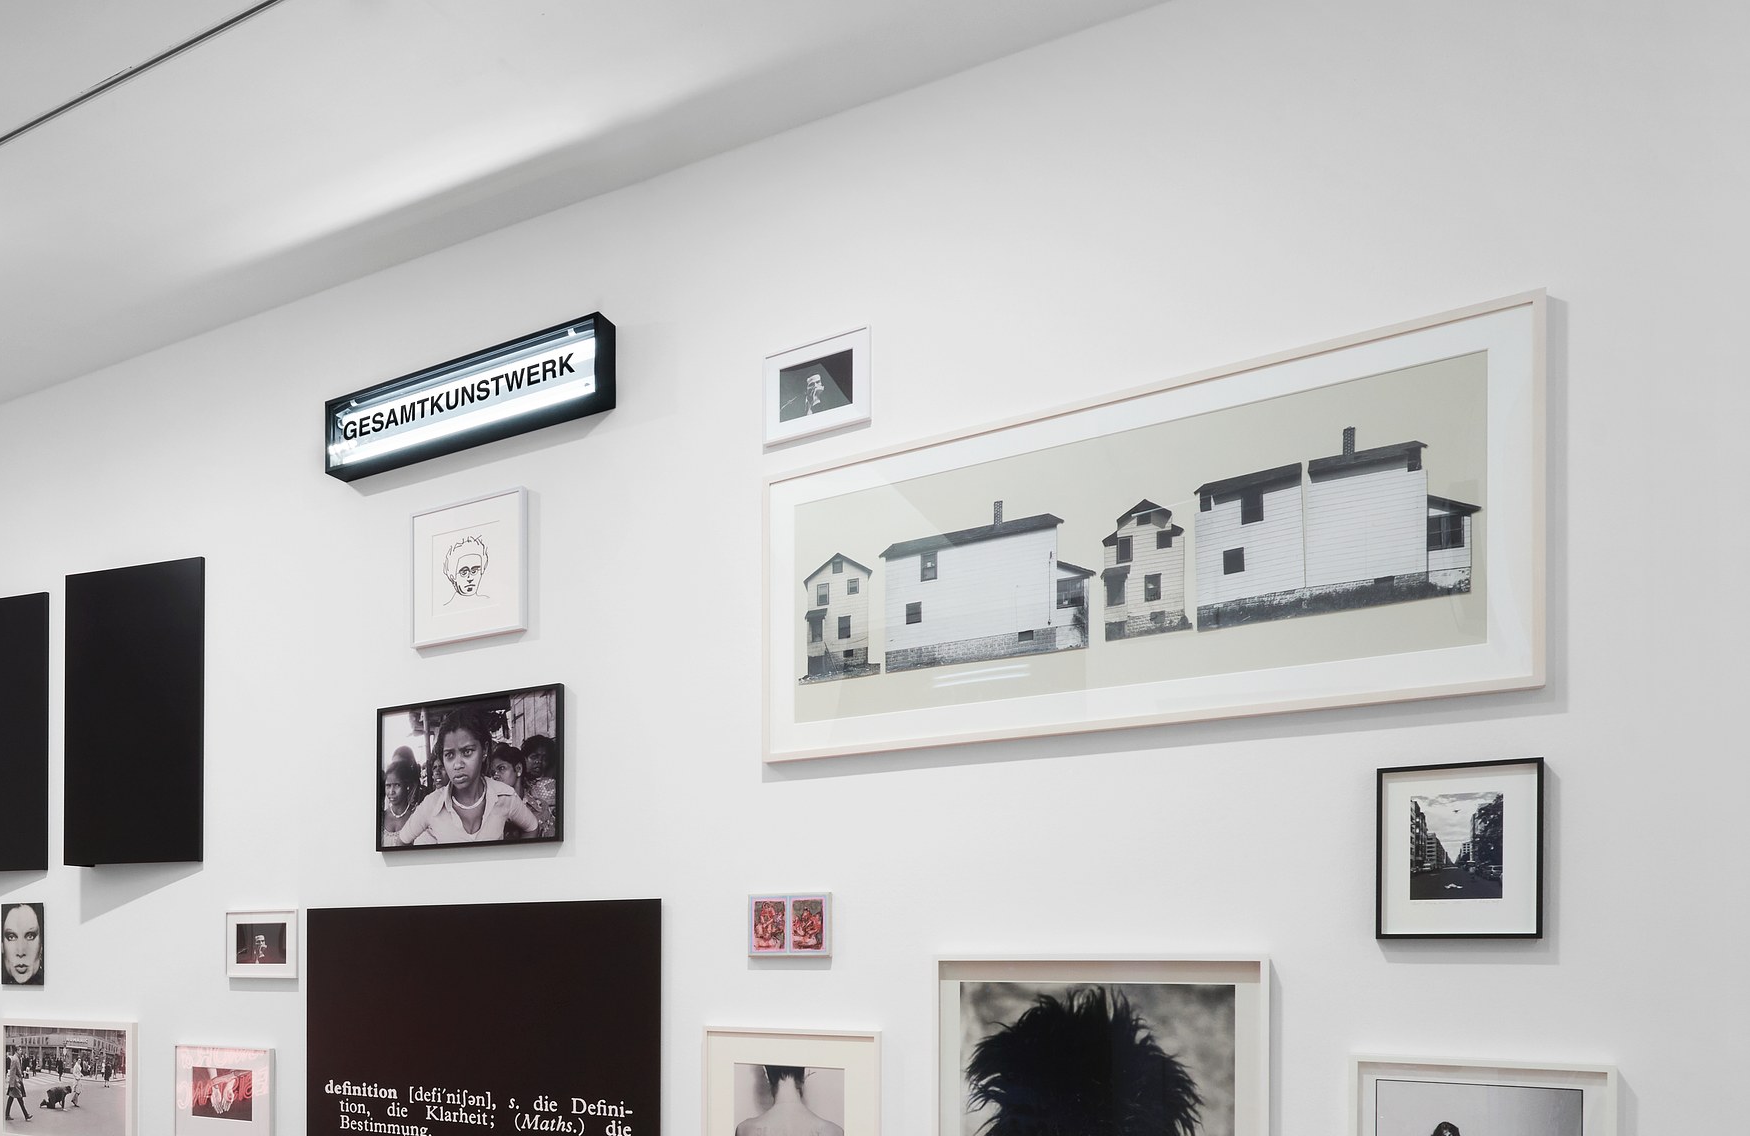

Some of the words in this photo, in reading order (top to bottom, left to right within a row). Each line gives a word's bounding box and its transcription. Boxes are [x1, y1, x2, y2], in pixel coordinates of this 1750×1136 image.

[342, 352, 575, 441] GESAMTKUNSTWERK
[324, 1079, 398, 1100] definition
[508, 1097, 520, 1110] s.
[533, 1095, 558, 1113] die
[570, 1097, 634, 1118] Defini-
[338, 1099, 371, 1118] tion,
[386, 1101, 409, 1118] die
[425, 1104, 495, 1129] Klarheit;
[514, 1112, 585, 1136] (Maths.)
